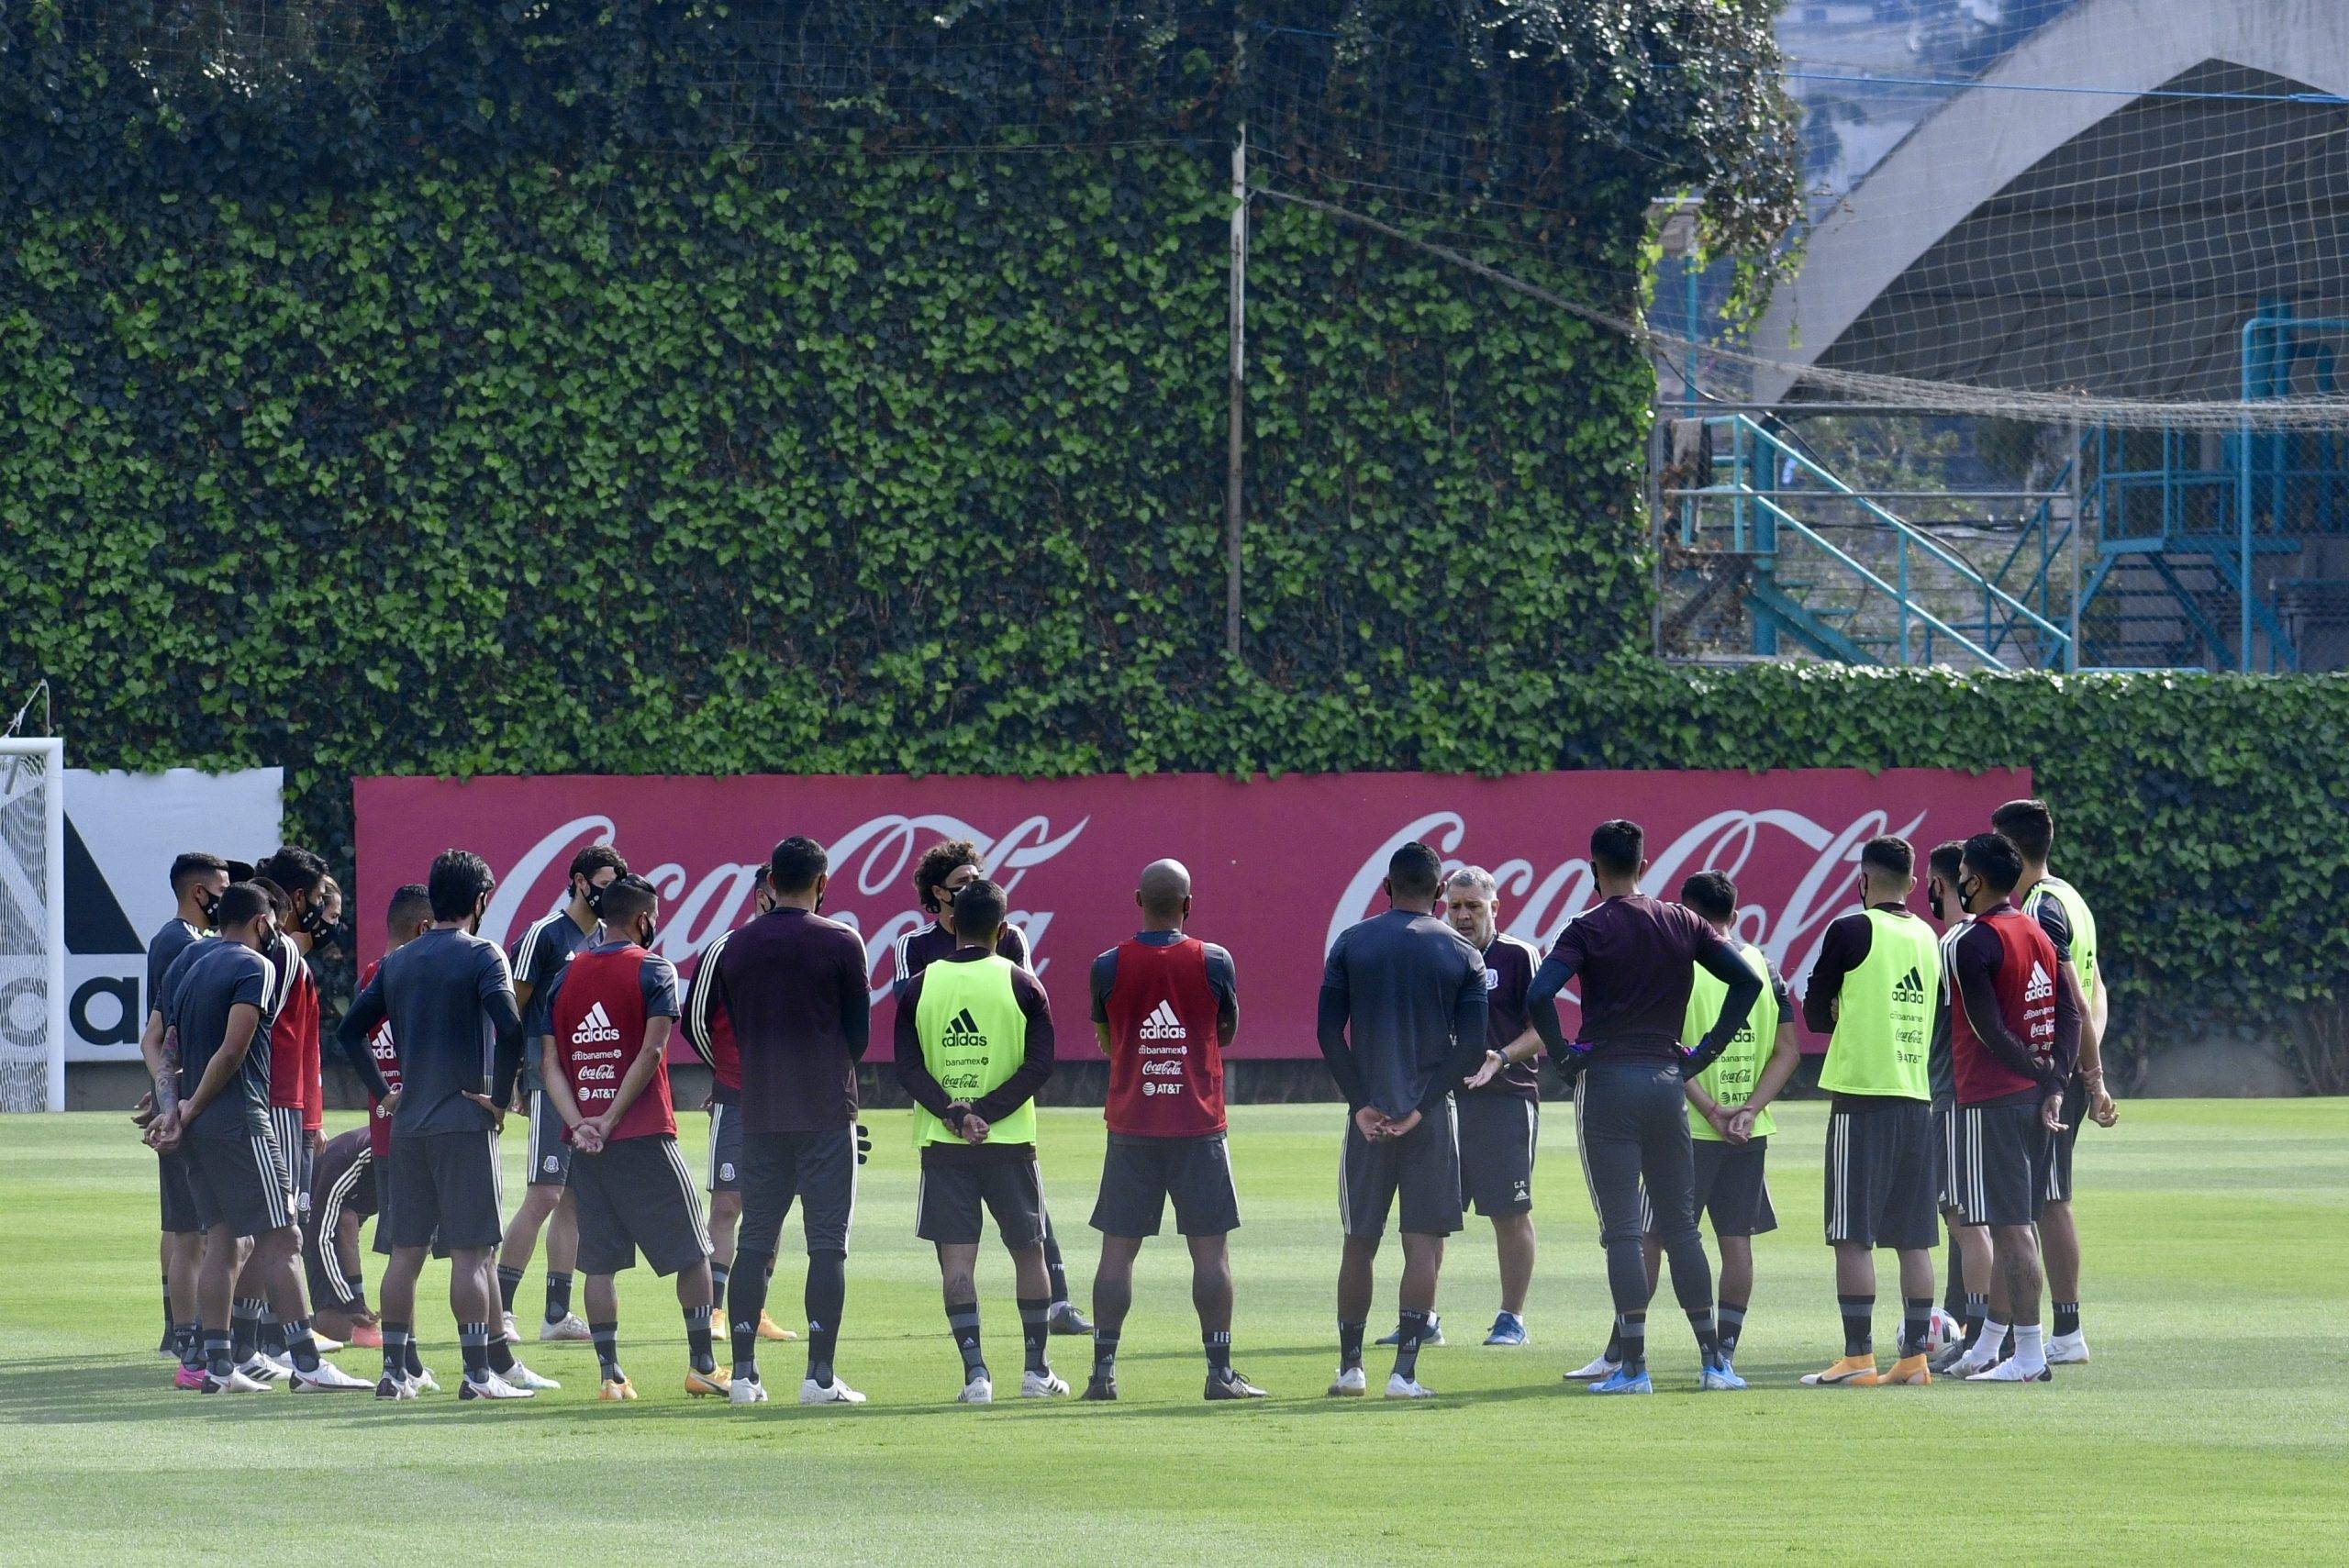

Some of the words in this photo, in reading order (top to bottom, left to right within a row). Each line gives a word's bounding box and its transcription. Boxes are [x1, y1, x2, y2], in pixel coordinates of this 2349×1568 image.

[572, 1028, 620, 1044] adidas
[1140, 1025, 1186, 1040] adidas
[1139, 1045, 1182, 1055] citibanamex
[591, 1088, 618, 1099] AT&T
[1157, 1084, 1184, 1095] AT&T
